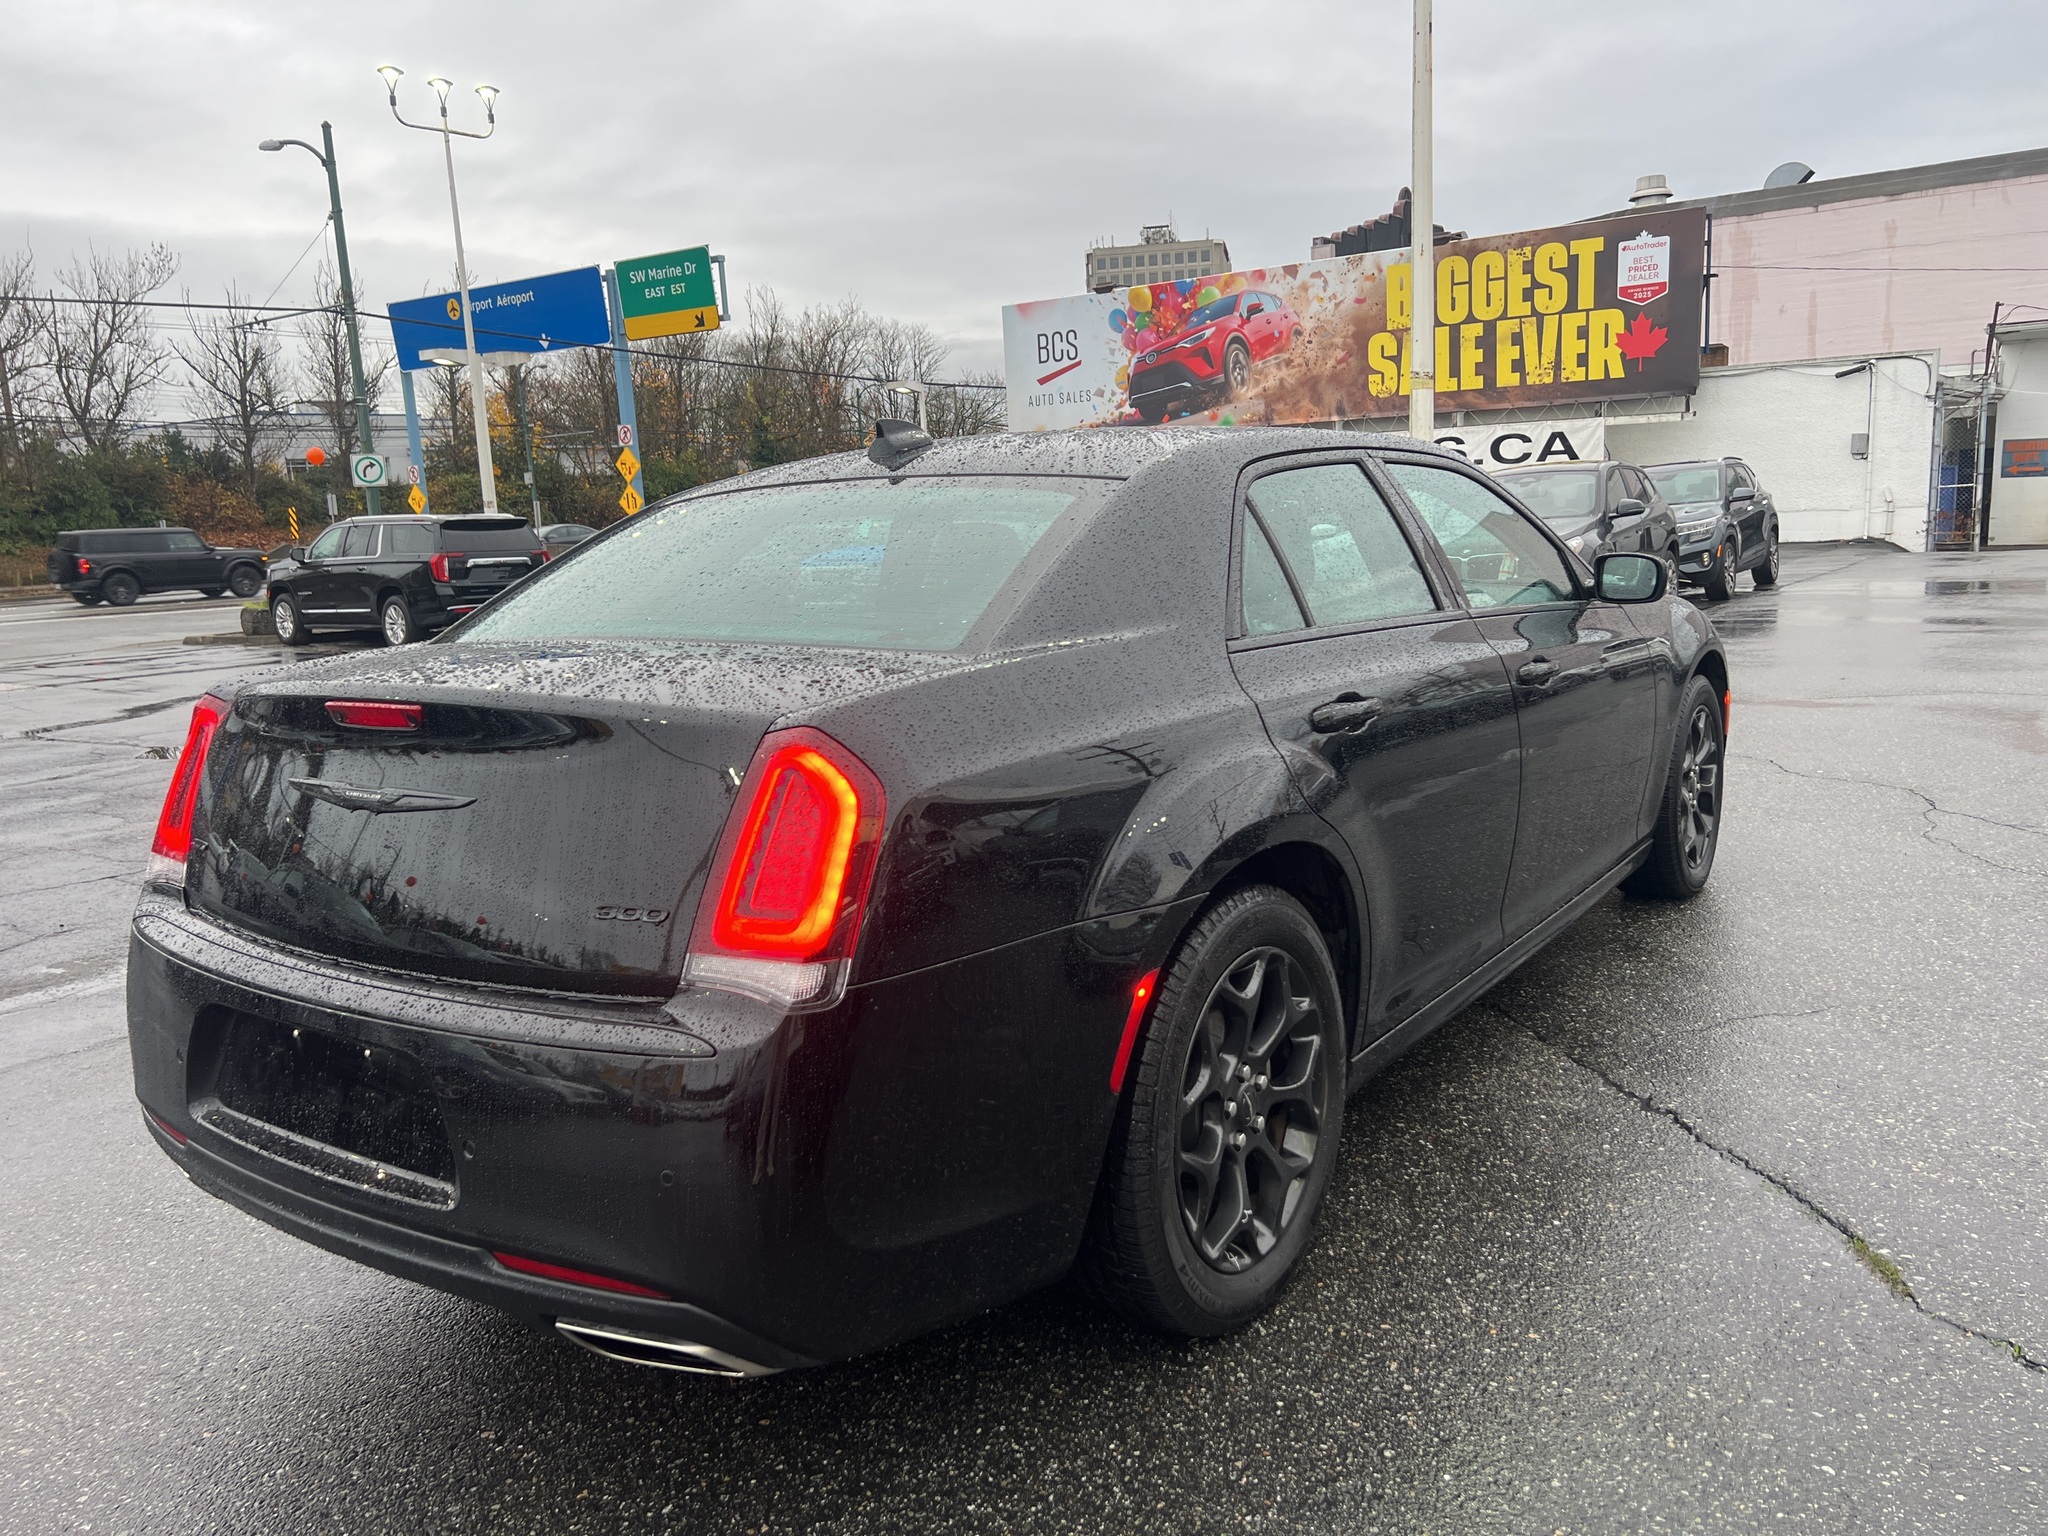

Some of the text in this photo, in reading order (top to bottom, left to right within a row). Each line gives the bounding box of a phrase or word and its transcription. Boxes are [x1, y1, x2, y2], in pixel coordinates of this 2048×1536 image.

[1626, 241, 1667, 251] AutoTrader
[1628, 263, 1659, 273] PRICED
[1633, 255, 1654, 265] BEST
[629, 262, 697, 284] SW Marine Dr
[1627, 272, 1659, 282] DEALER
[645, 283, 686, 299] EAST EST
[1386, 237, 1605, 331] BGGEST
[469, 290, 535, 314] irport Aéroport
[1633, 291, 1652, 299] 2025
[1037, 329, 1078, 364] BCS
[1496, 308, 1626, 388] EVER
[1028, 389, 1092, 407] AUTO SALES
[594, 903, 671, 923] 300
